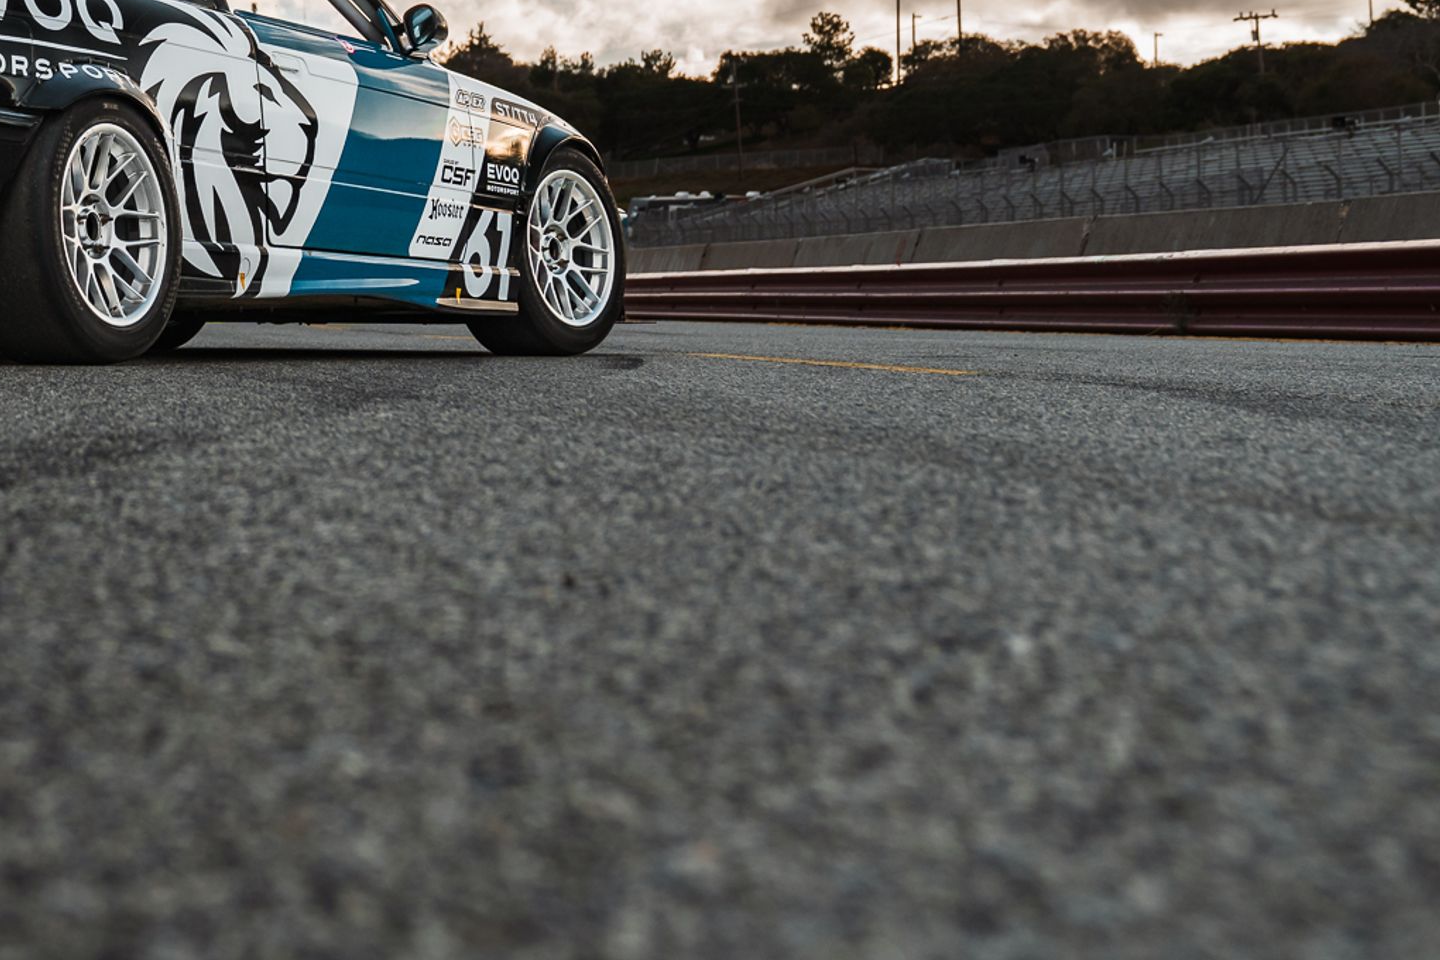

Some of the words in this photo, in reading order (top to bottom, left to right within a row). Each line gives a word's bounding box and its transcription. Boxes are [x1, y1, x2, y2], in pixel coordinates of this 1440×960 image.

[441, 165, 476, 186] CSF
[487, 162, 520, 184] EVOQ
[428, 198, 464, 220] Hoosier
[416, 234, 452, 247] nasa
[461, 210, 513, 300] 61
